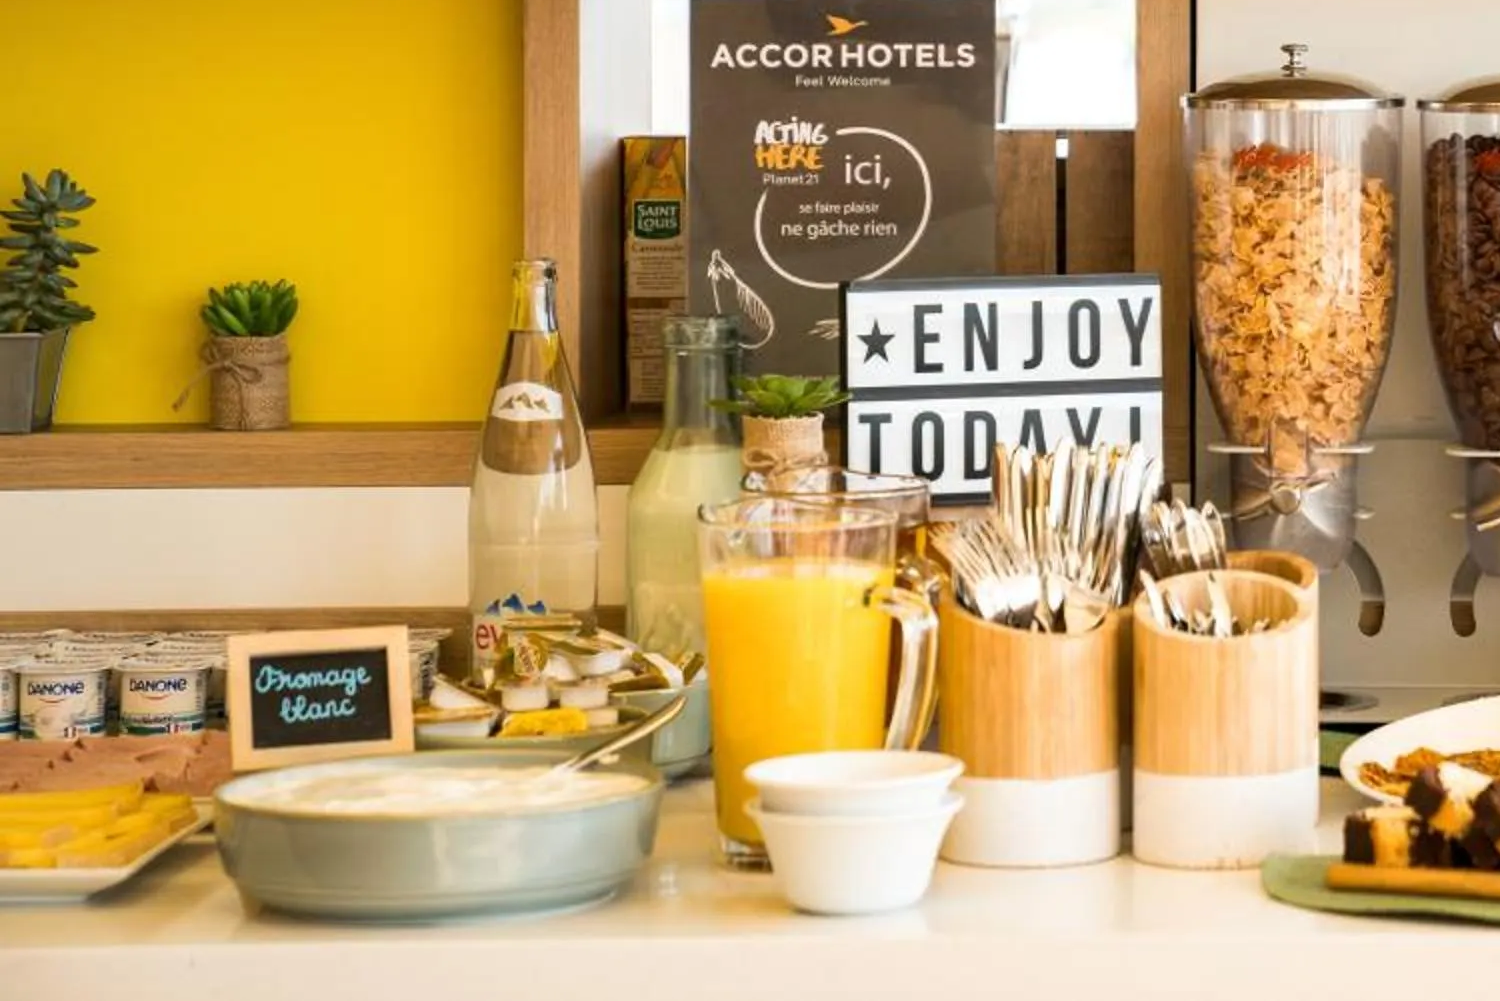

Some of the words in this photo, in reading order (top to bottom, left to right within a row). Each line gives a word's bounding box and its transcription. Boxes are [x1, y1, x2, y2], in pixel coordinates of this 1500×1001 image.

[795, 75, 824, 87] Feel
[827, 75, 891, 88] Welcome
[755, 145, 825, 170] HERE
[844, 154, 892, 190] ici,
[798, 204, 813, 214] se
[815, 202, 841, 214] faire
[843, 202, 879, 216] plaisir
[780, 224, 803, 237] ne
[806, 218, 861, 240] gâche
[863, 221, 898, 237] rien
[914, 297, 1153, 374] ENJOY
[255, 664, 373, 696] Fromage
[279, 695, 356, 724] blanc
